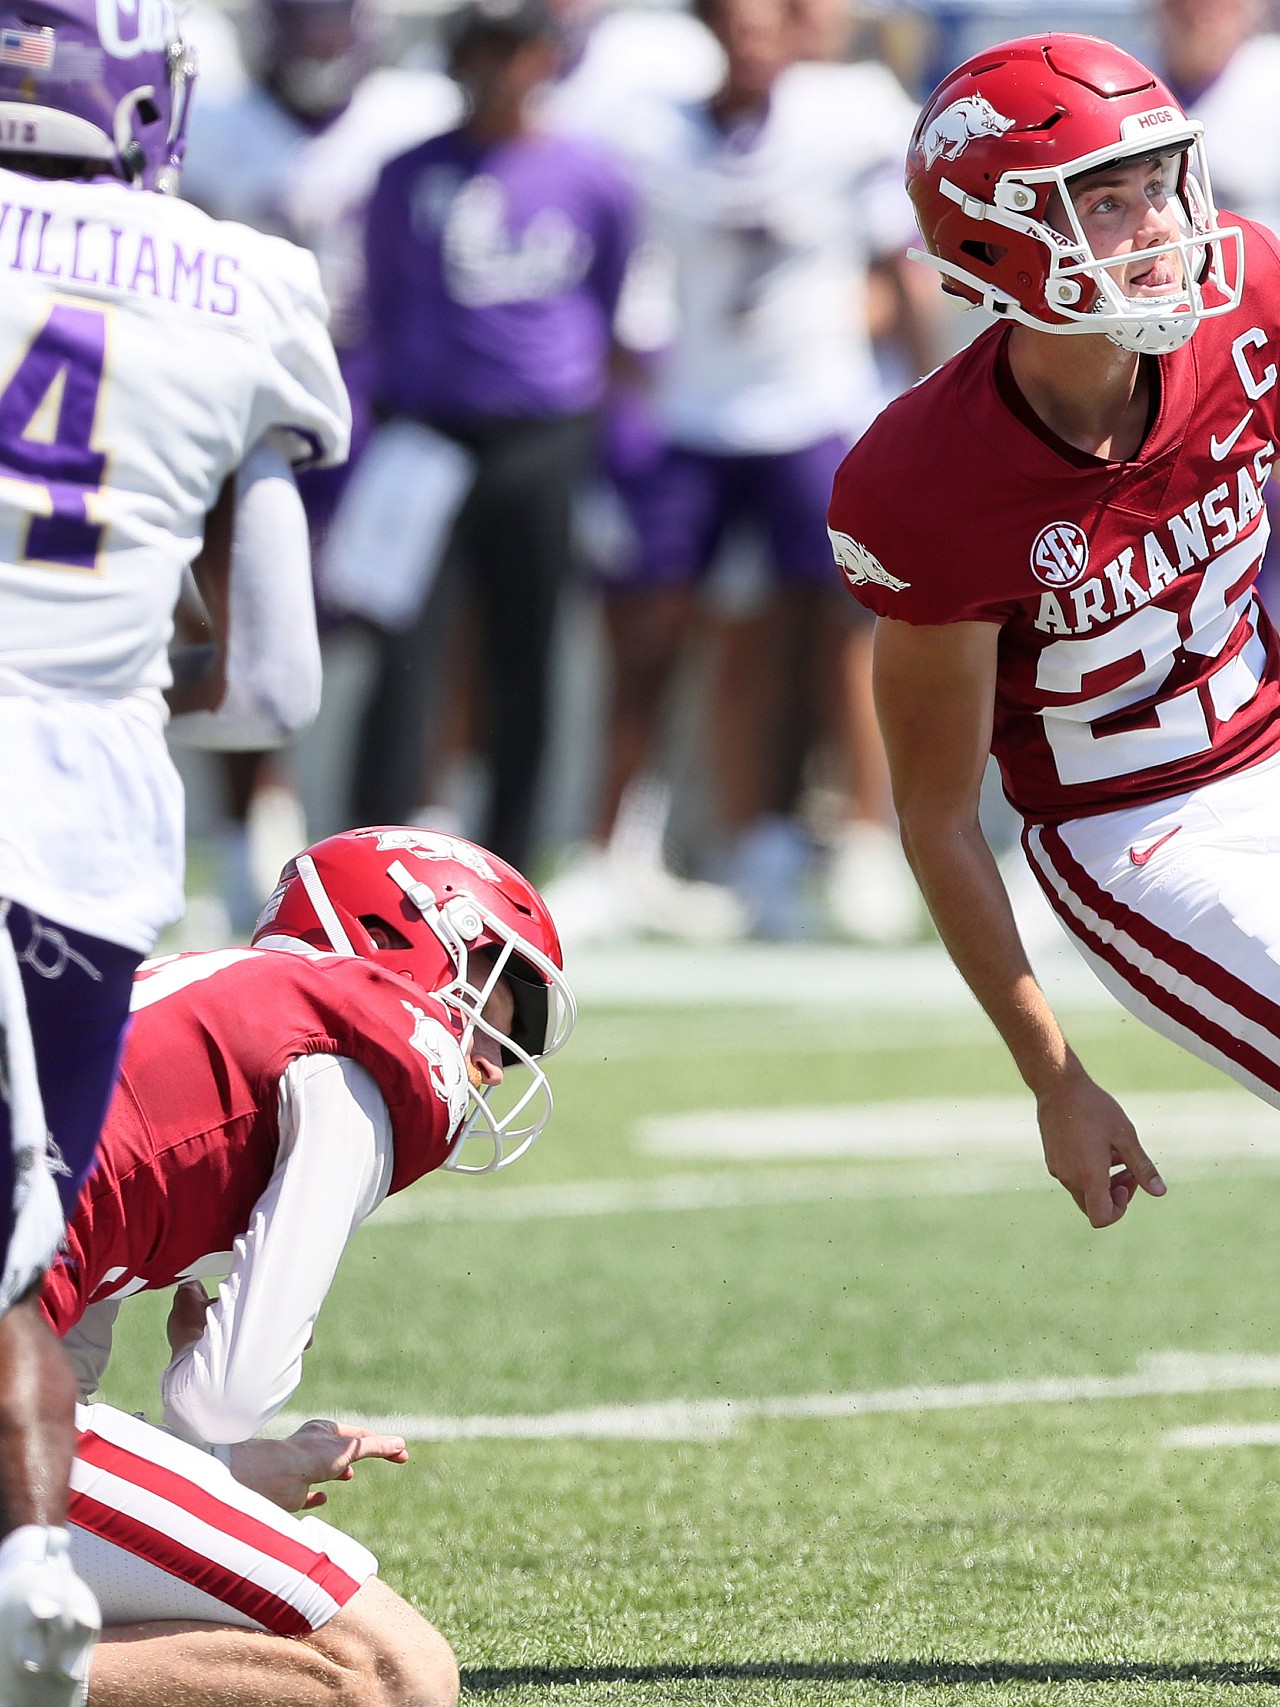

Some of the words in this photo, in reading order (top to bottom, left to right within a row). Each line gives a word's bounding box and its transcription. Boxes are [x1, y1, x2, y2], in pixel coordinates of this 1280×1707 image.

[1138, 110, 1174, 129] HOGS
[1231, 326, 1278, 401] C
[1034, 439, 1276, 635] ARKANSAS
[1034, 526, 1085, 583] SEC
